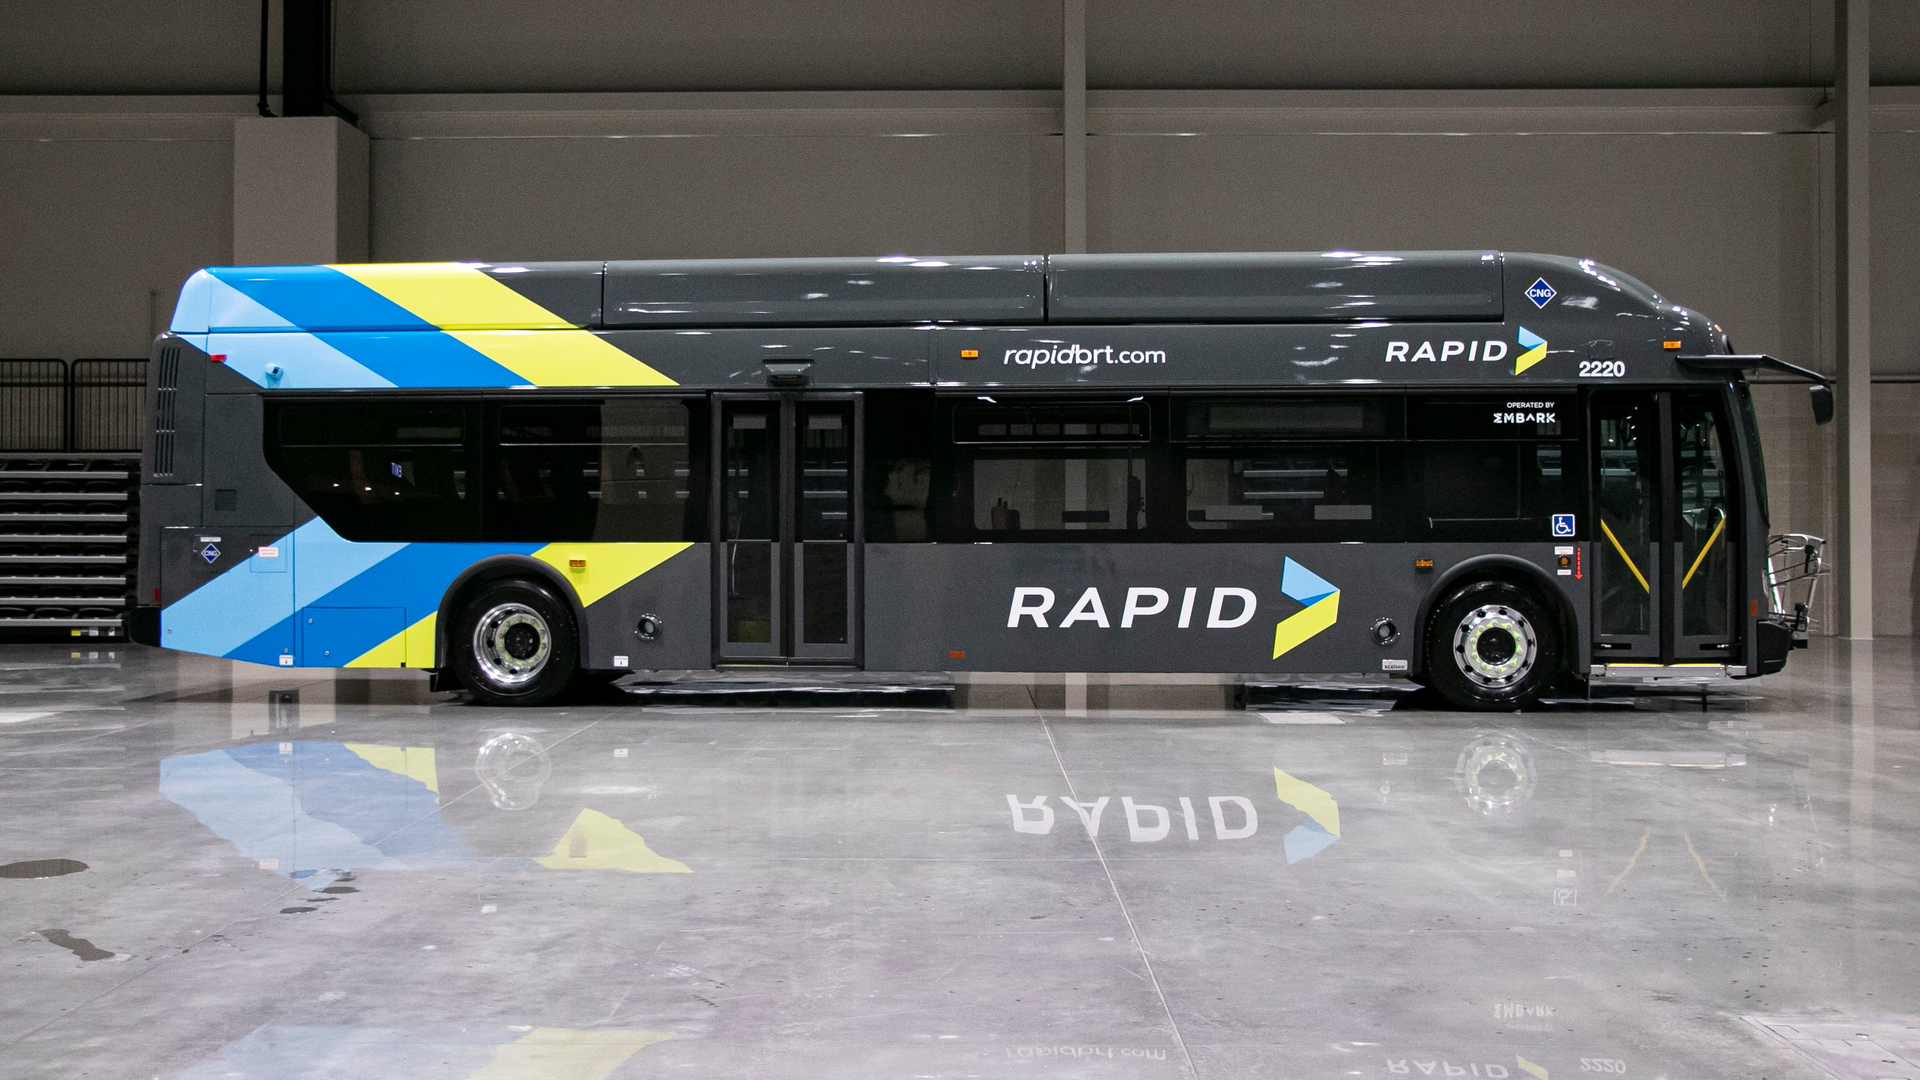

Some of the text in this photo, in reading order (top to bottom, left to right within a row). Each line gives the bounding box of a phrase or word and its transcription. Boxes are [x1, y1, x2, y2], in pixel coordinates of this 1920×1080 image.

[1529, 288, 1552, 298] CNG
[1003, 344, 1167, 369] rapidbrt.com
[1384, 340, 1508, 362] RAPID
[1578, 360, 1626, 378] 2220
[1506, 401, 1555, 409] OPERATED BY
[1006, 586, 1258, 629] RAPID
